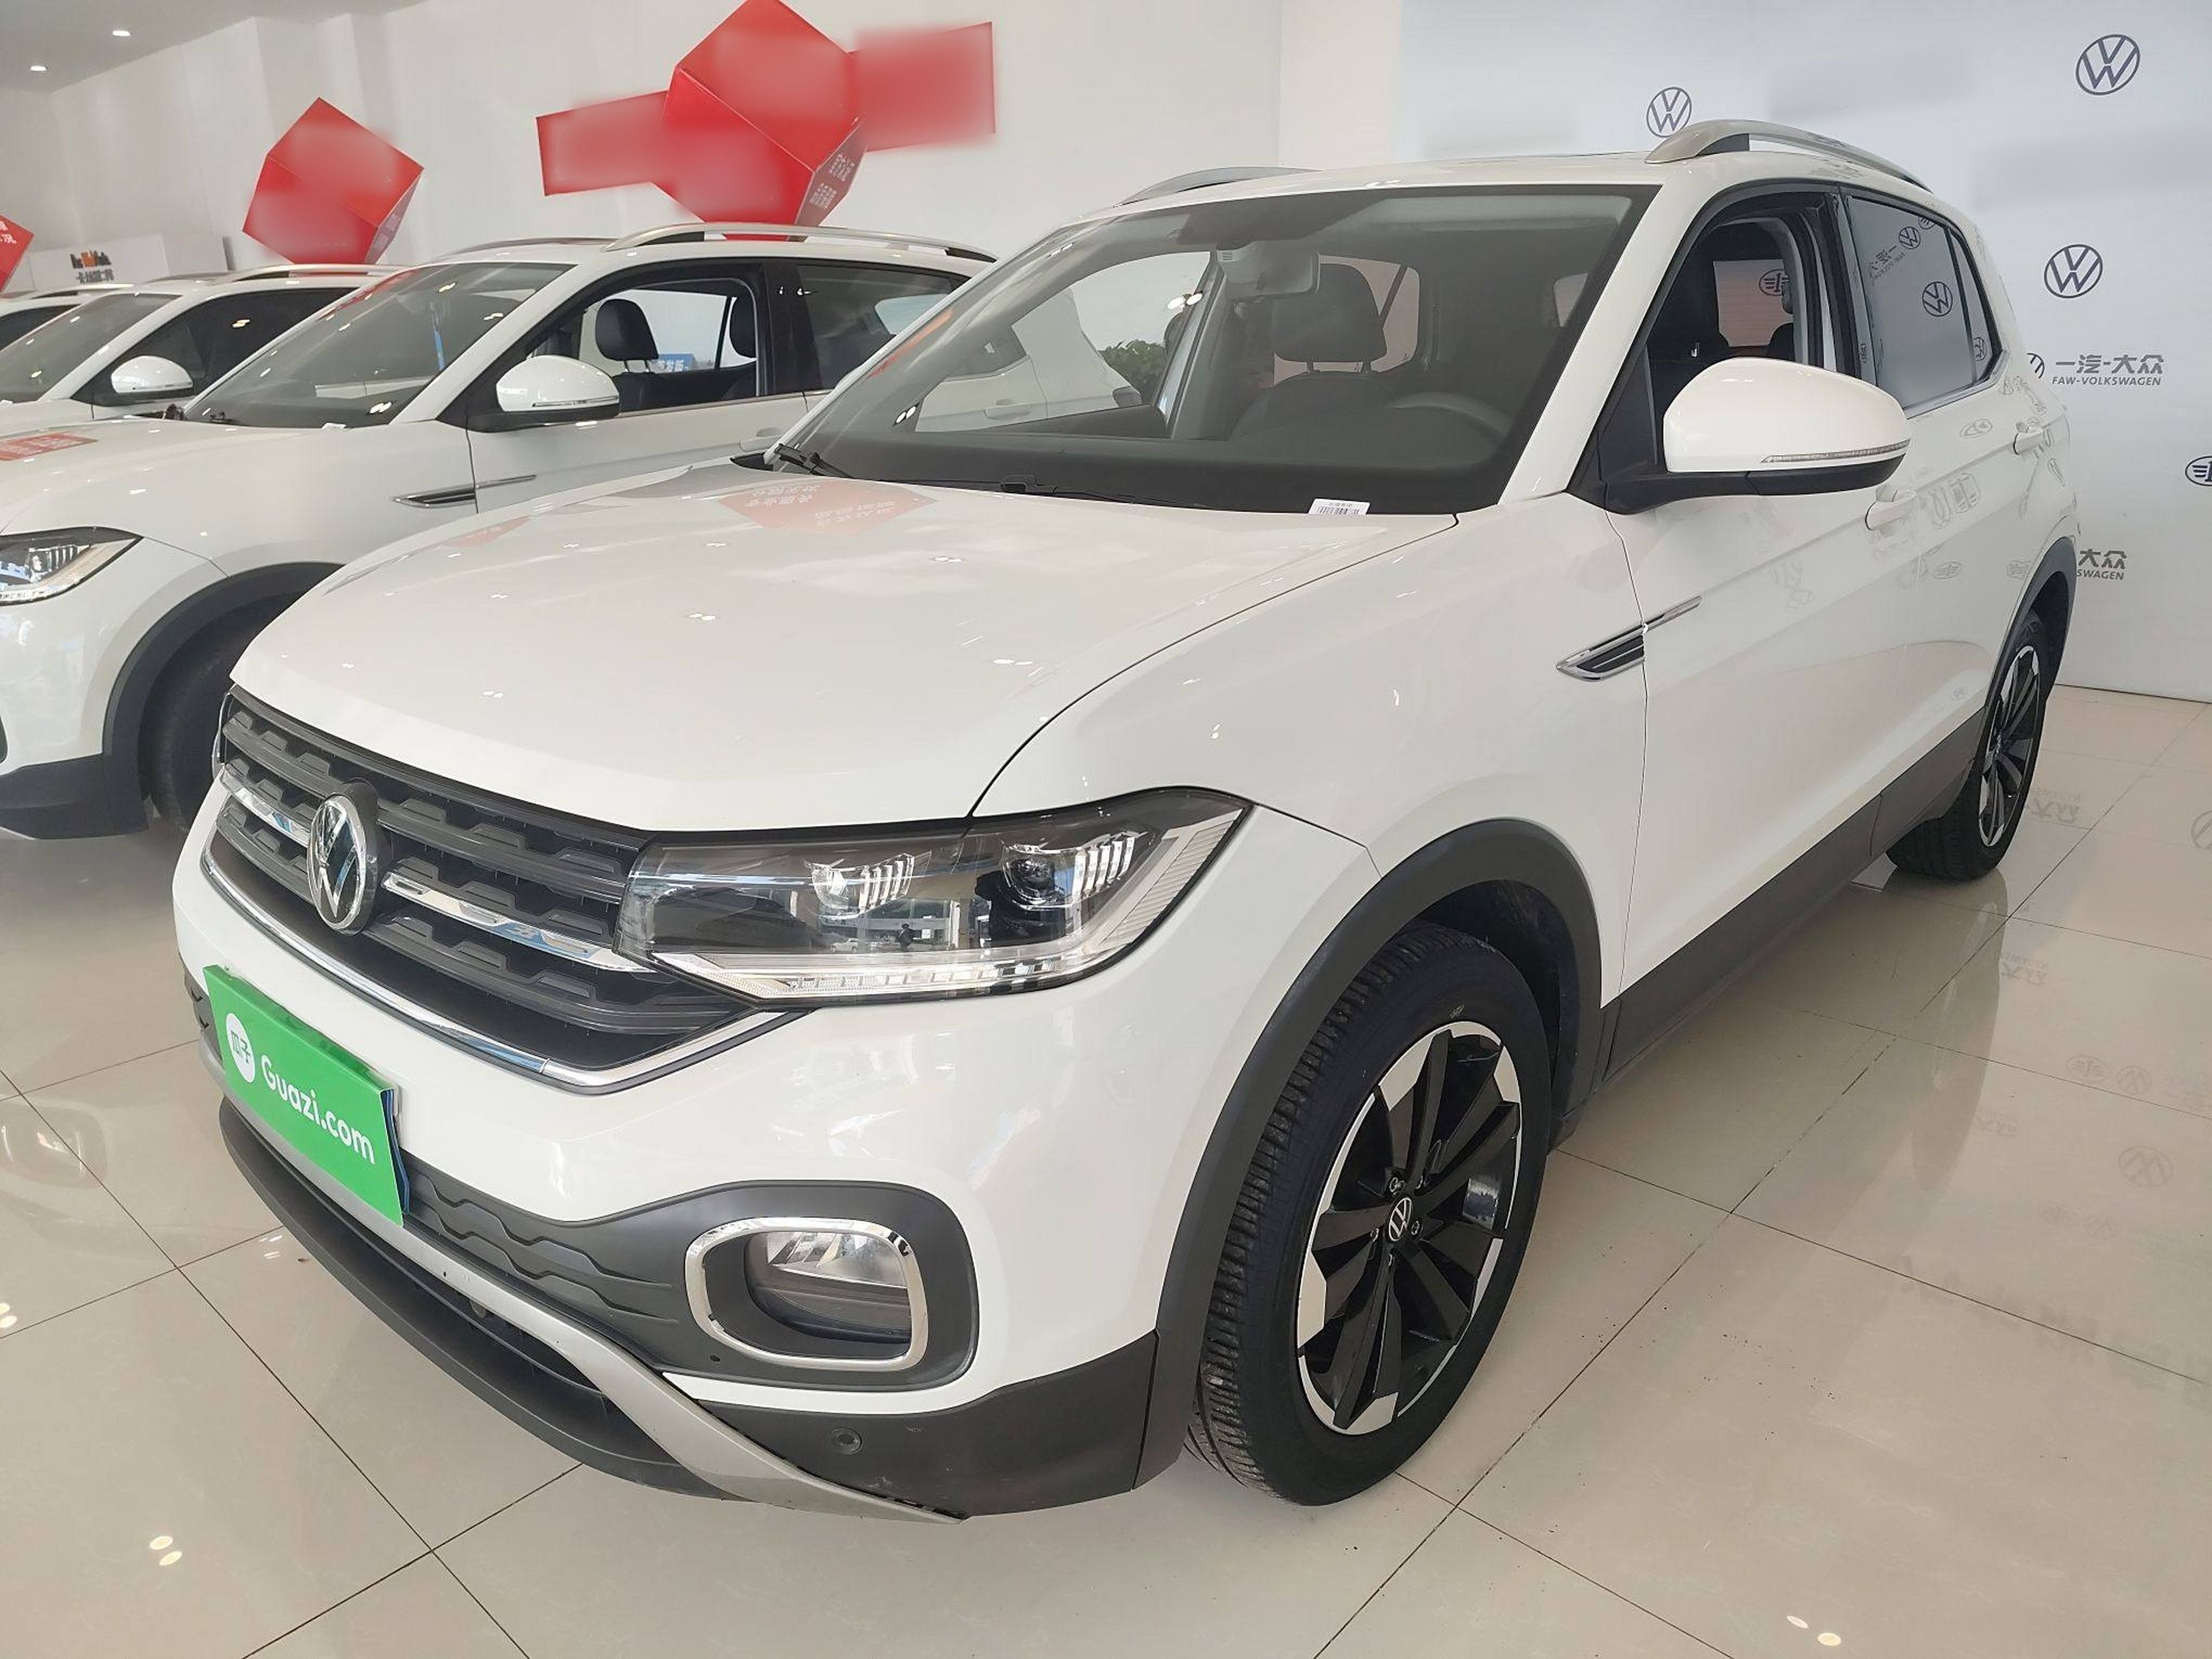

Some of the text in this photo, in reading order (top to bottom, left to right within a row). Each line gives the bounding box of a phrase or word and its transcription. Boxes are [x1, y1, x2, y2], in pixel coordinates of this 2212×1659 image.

[2055, 354, 2164, 375] 一汽-大众
[2051, 376, 2162, 386] FAW-VOLKSWAGEN
[230, 1028, 252, 1065] 瓜子
[260, 1054, 376, 1164] Guazi.com
